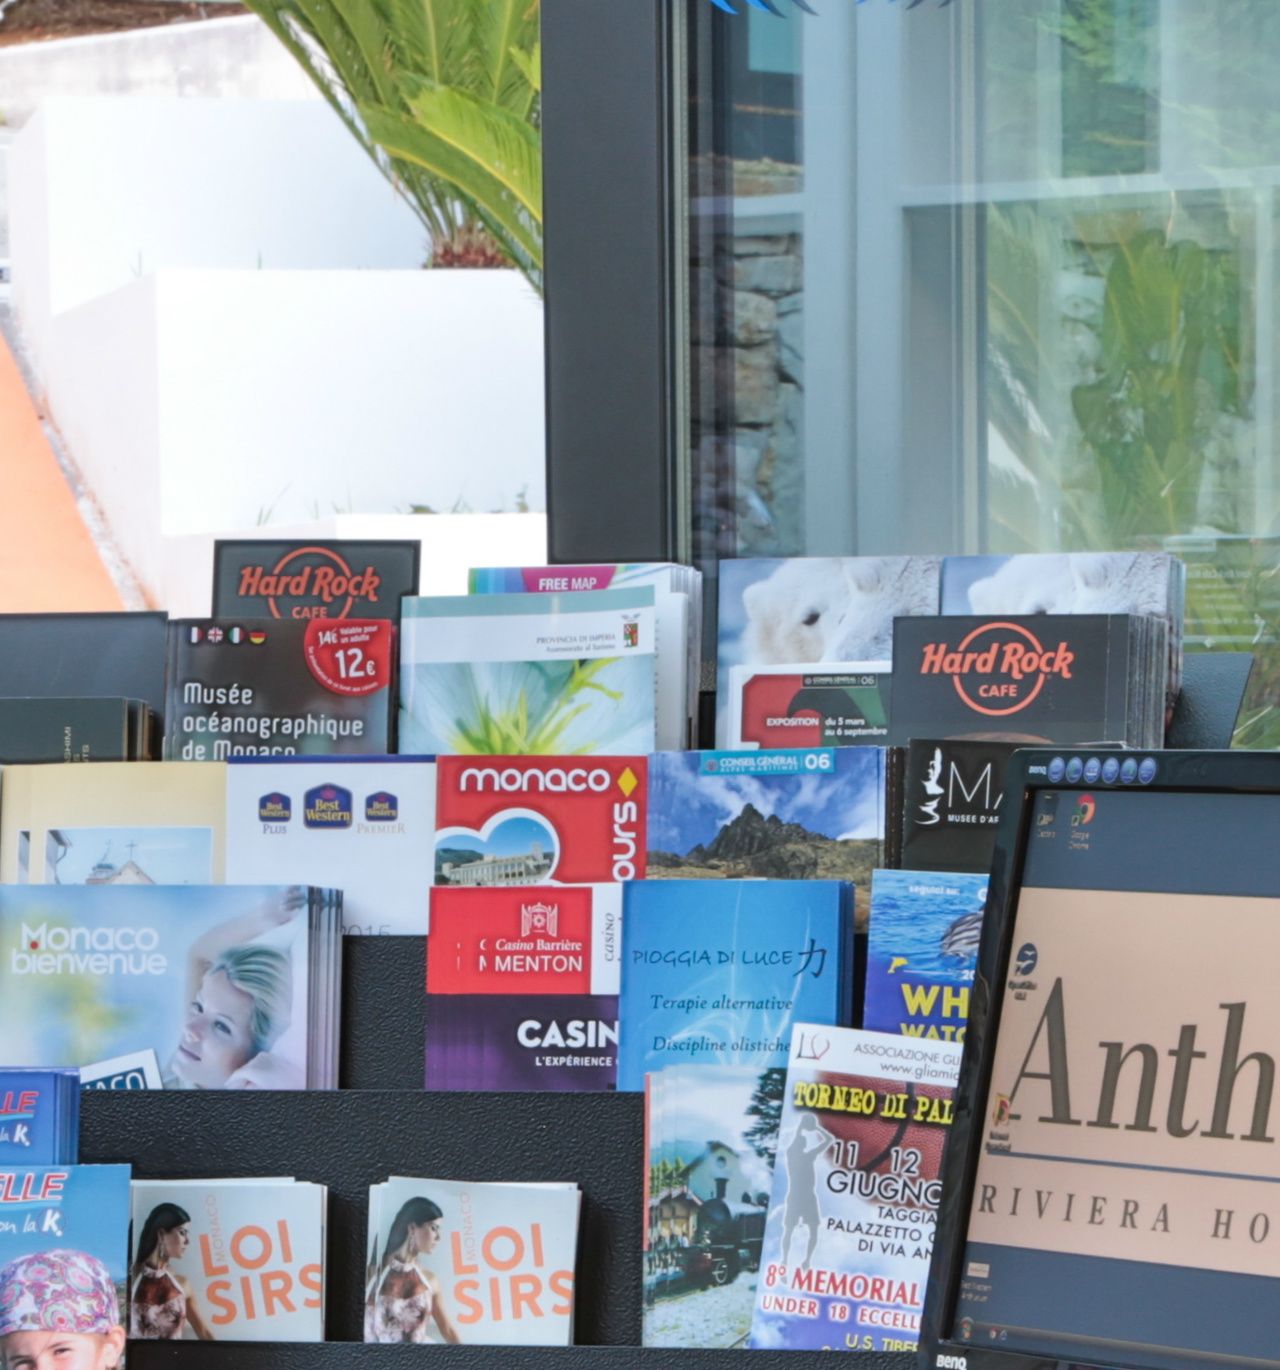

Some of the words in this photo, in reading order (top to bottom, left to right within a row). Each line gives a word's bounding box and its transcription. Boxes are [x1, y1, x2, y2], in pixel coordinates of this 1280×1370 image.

[238, 566, 311, 597] Hard
[312, 566, 381, 602] Rock
[538, 577, 569, 591] FREE
[571, 577, 597, 590] MAP
[291, 606, 328, 619] CAFE
[536, 636, 578, 644] PROVINCIA
[579, 635, 587, 643] DI
[588, 633, 616, 642] IMPERIA
[921, 642, 1000, 674] Hard
[1000, 642, 1074, 680] Rock
[861, 676, 875, 685] 06
[183, 682, 253, 704] Musée
[978, 684, 1018, 697] CAFE
[182, 712, 364, 740] océanographique
[766, 717, 819, 727] EXPOSITION
[825, 717, 836, 725] du
[838, 717, 844, 725] 5
[824, 728, 835, 736] au
[844, 727, 888, 738] septembre
[182, 740, 206, 760] de
[720, 757, 756, 767] CONSEIL
[804, 753, 831, 770] 06
[460, 768, 611, 792] monaco
[259, 809, 290, 817] Western
[265, 802, 283, 810] Best
[315, 799, 339, 811] Best
[367, 807, 396, 816] Western
[372, 801, 389, 809] Best
[306, 809, 350, 822] Western
[263, 823, 287, 834] PLUS
[356, 822, 406, 834] PREMIER
[21, 922, 159, 951] Monaco
[495, 938, 534, 951] Casino
[536, 938, 583, 951] Barrière
[11, 948, 168, 976] bienvenue
[495, 955, 583, 972] MENTON
[633, 949, 712, 967] PIOGGIA
[717, 950, 734, 965] DI
[742, 950, 793, 966] LUCE
[650, 994, 708, 1013] Terapie
[712, 995, 793, 1010] alternative
[653, 1036, 727, 1055] Discipline
[731, 1036, 791, 1051] olistiche
[854, 1043, 940, 1064] ASSOCIAZIONE
[535, 1055, 612, 1067] L'EXPÉRIENCE
[794, 1081, 876, 1115] TORNEO
[880, 1093, 909, 1119] DI
[0, 1128, 11, 1142] la
[833, 1141, 859, 1168] 11
[891, 1147, 921, 1175] 12
[878, 1206, 937, 1224] TAGGIA
[978, 1183, 1172, 1236] RIVIERA
[23, 1215, 37, 1233] la
[827, 1217, 922, 1242] PALAZZETTO
[200, 1219, 293, 1278] LOI
[450, 1223, 545, 1276] LOI
[858, 1239, 873, 1253] DI
[880, 1242, 906, 1257] VIA
[206, 1263, 321, 1325] SIRS
[765, 1265, 786, 1287] 8°
[791, 1267, 920, 1306] MEMORIAL
[454, 1269, 575, 1325] SIRS
[763, 1295, 818, 1316] UNDER
[830, 1305, 847, 1319] 18
